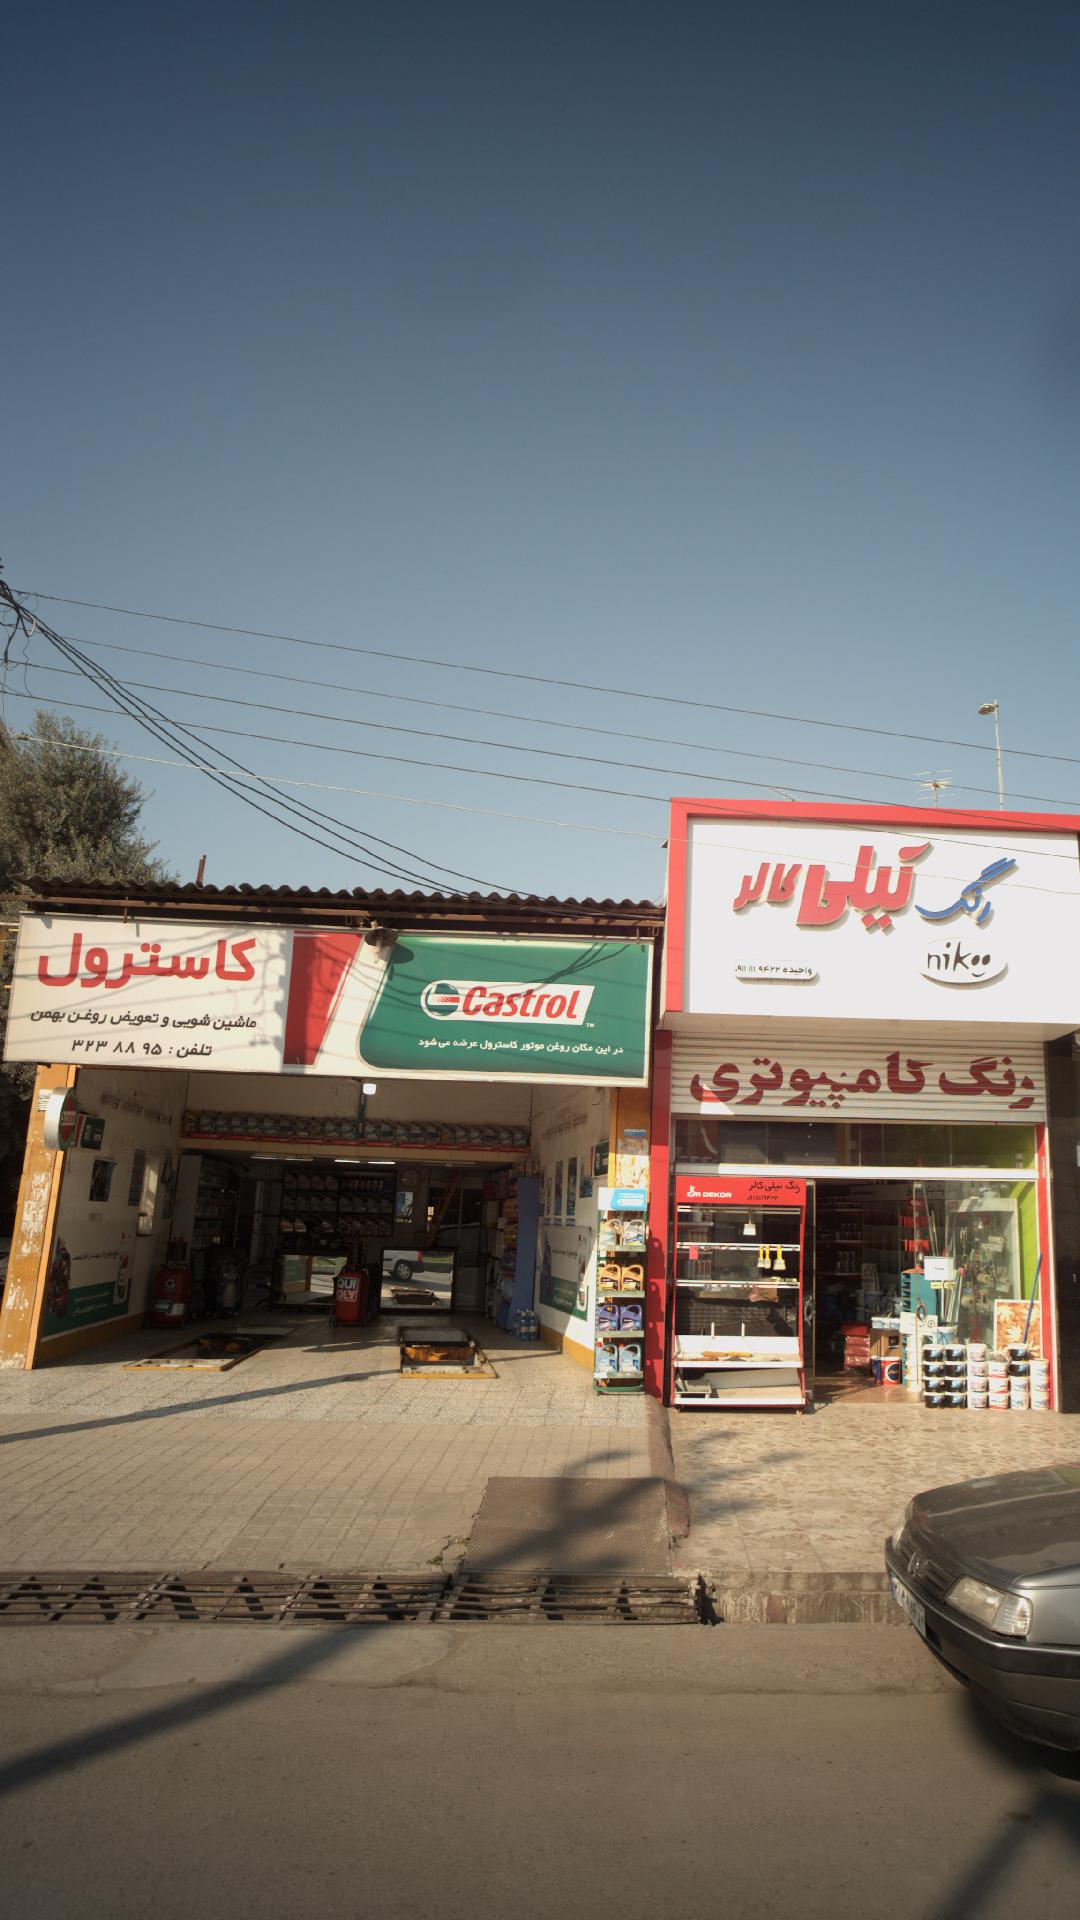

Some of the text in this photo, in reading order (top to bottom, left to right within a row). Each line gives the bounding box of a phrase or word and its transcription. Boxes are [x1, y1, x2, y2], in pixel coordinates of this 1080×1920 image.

[733, 841, 1016, 928] رنگ نیلی کالر
[38, 932, 256, 989] کاسترول
[462, 985, 581, 1019] Castrol
[30, 1008, 257, 1031] ماشین شویی و تعویض روغن بهمن
[452, 1039, 478, 1049] عرضه
[479, 1039, 518, 1051] کاسترول
[519, 1041, 545, 1051] موتور
[546, 1041, 570, 1053] روغن
[571, 1043, 594, 1054] مکان
[595, 1044, 611, 1055] این
[612, 1046, 624, 1055] در
[690, 1051, 1035, 1109] رنگ کامپیوتری
